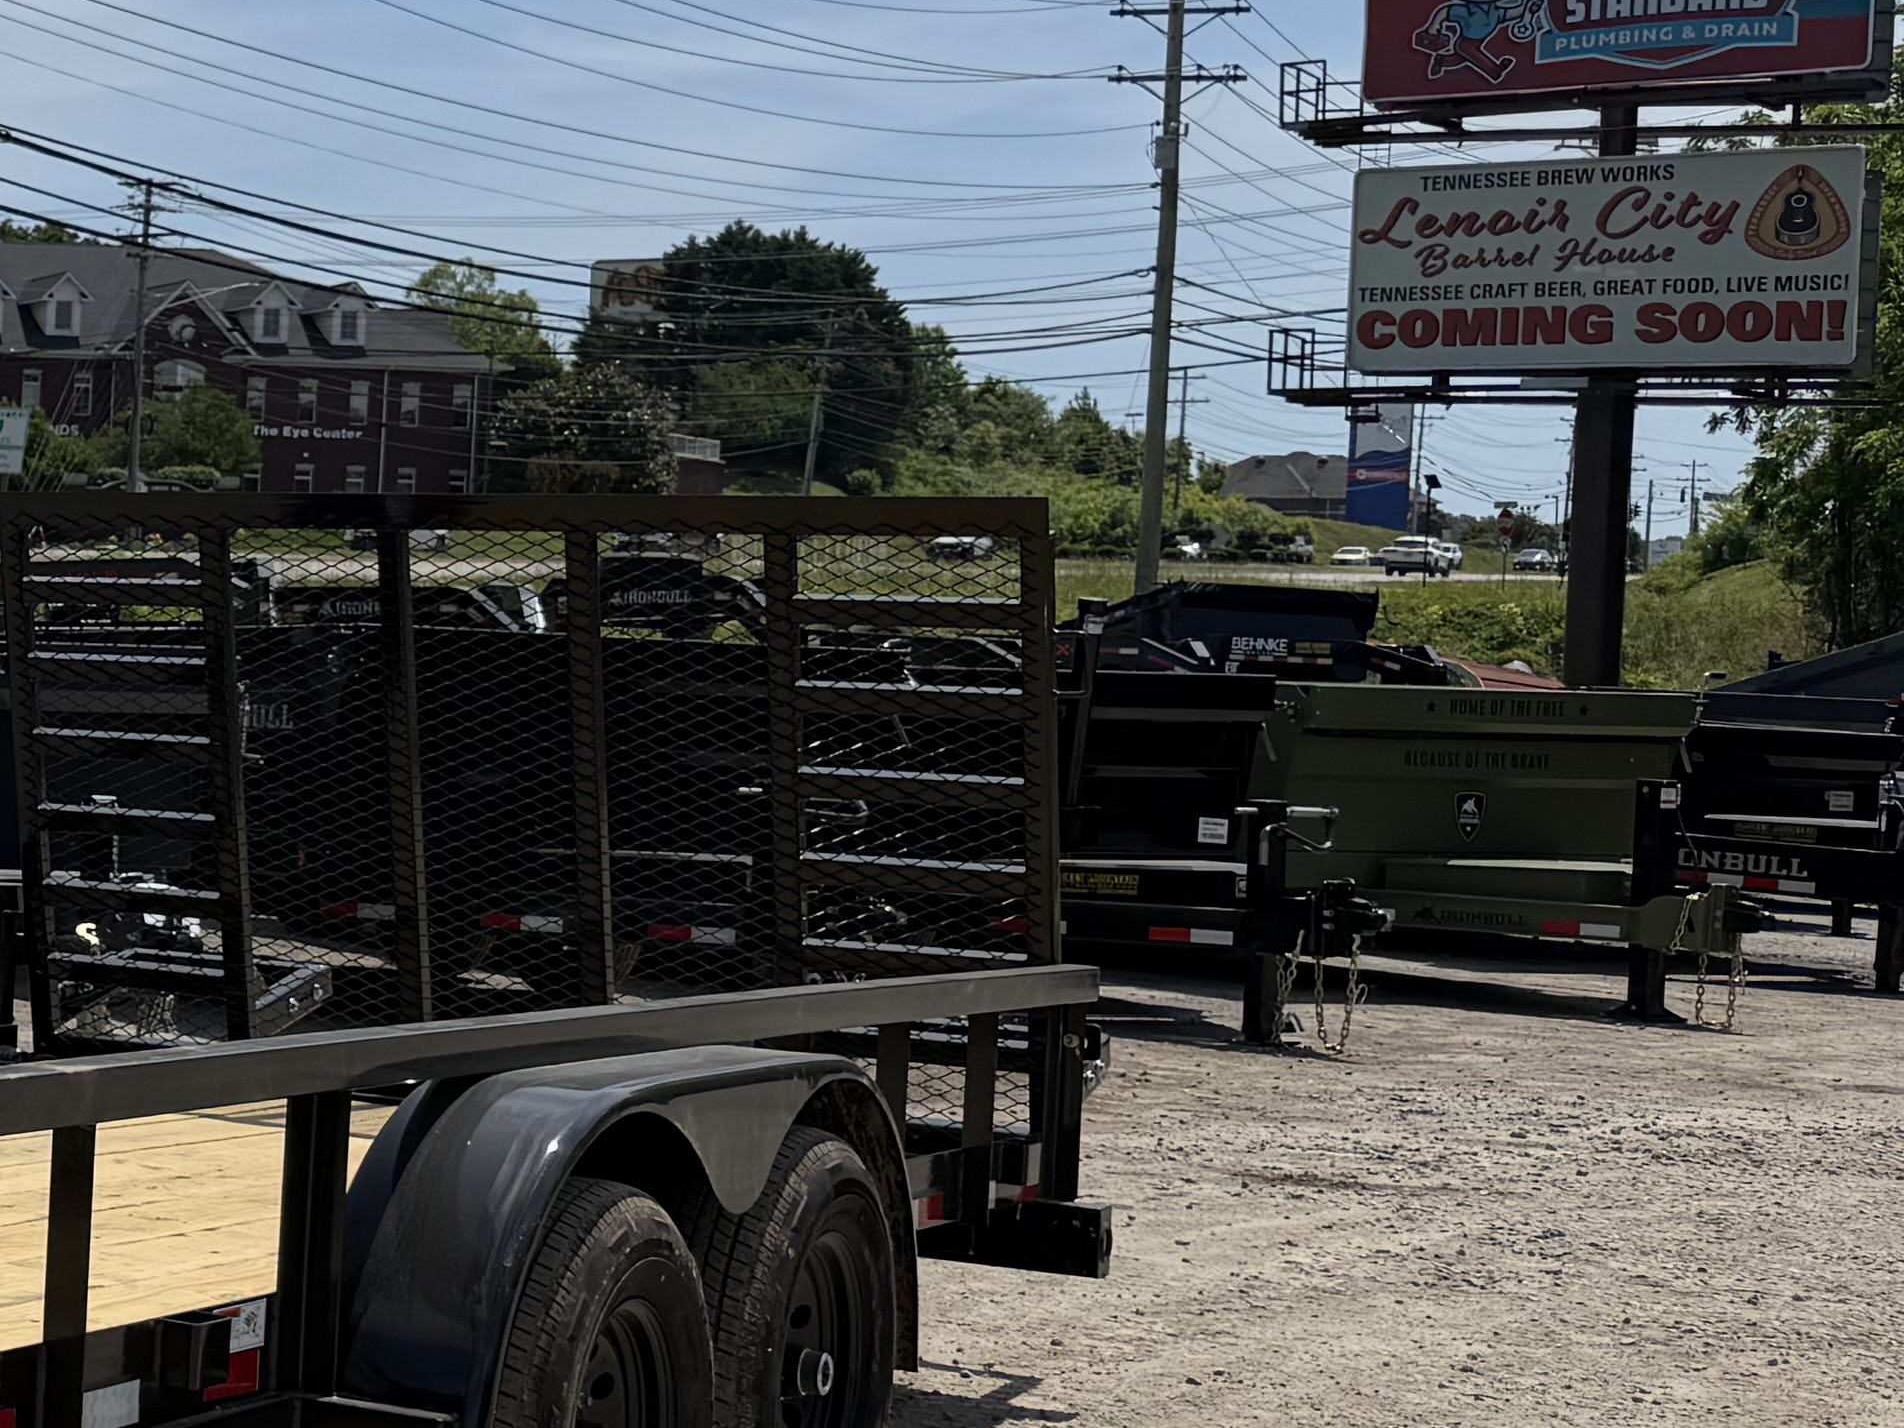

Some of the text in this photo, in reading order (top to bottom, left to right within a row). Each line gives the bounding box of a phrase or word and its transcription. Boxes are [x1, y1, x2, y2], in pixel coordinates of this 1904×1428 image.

[1555, 22, 1778, 51] PLUMBING & DRAIN
[1420, 164, 1675, 192] TENNESSEE BREW WORKS
[1358, 196, 1570, 249] Lenoir
[1596, 185, 1741, 245] City
[1414, 237, 1675, 278] Barrel House
[1358, 274, 1849, 303] TENNESSEE CRAFT BEER, GREAT FOOD, LIVE MUSIC!
[1357, 300, 1847, 350] COMING SOON!
[254, 425, 363, 440] The Eye Center
[1231, 636, 1288, 652] BEHNKE
[1450, 699, 1565, 717] HOME OF THE FREE
[1404, 750, 1459, 768] BECAUSE
[1465, 751, 1480, 768] OF
[1485, 752, 1506, 769] THE
